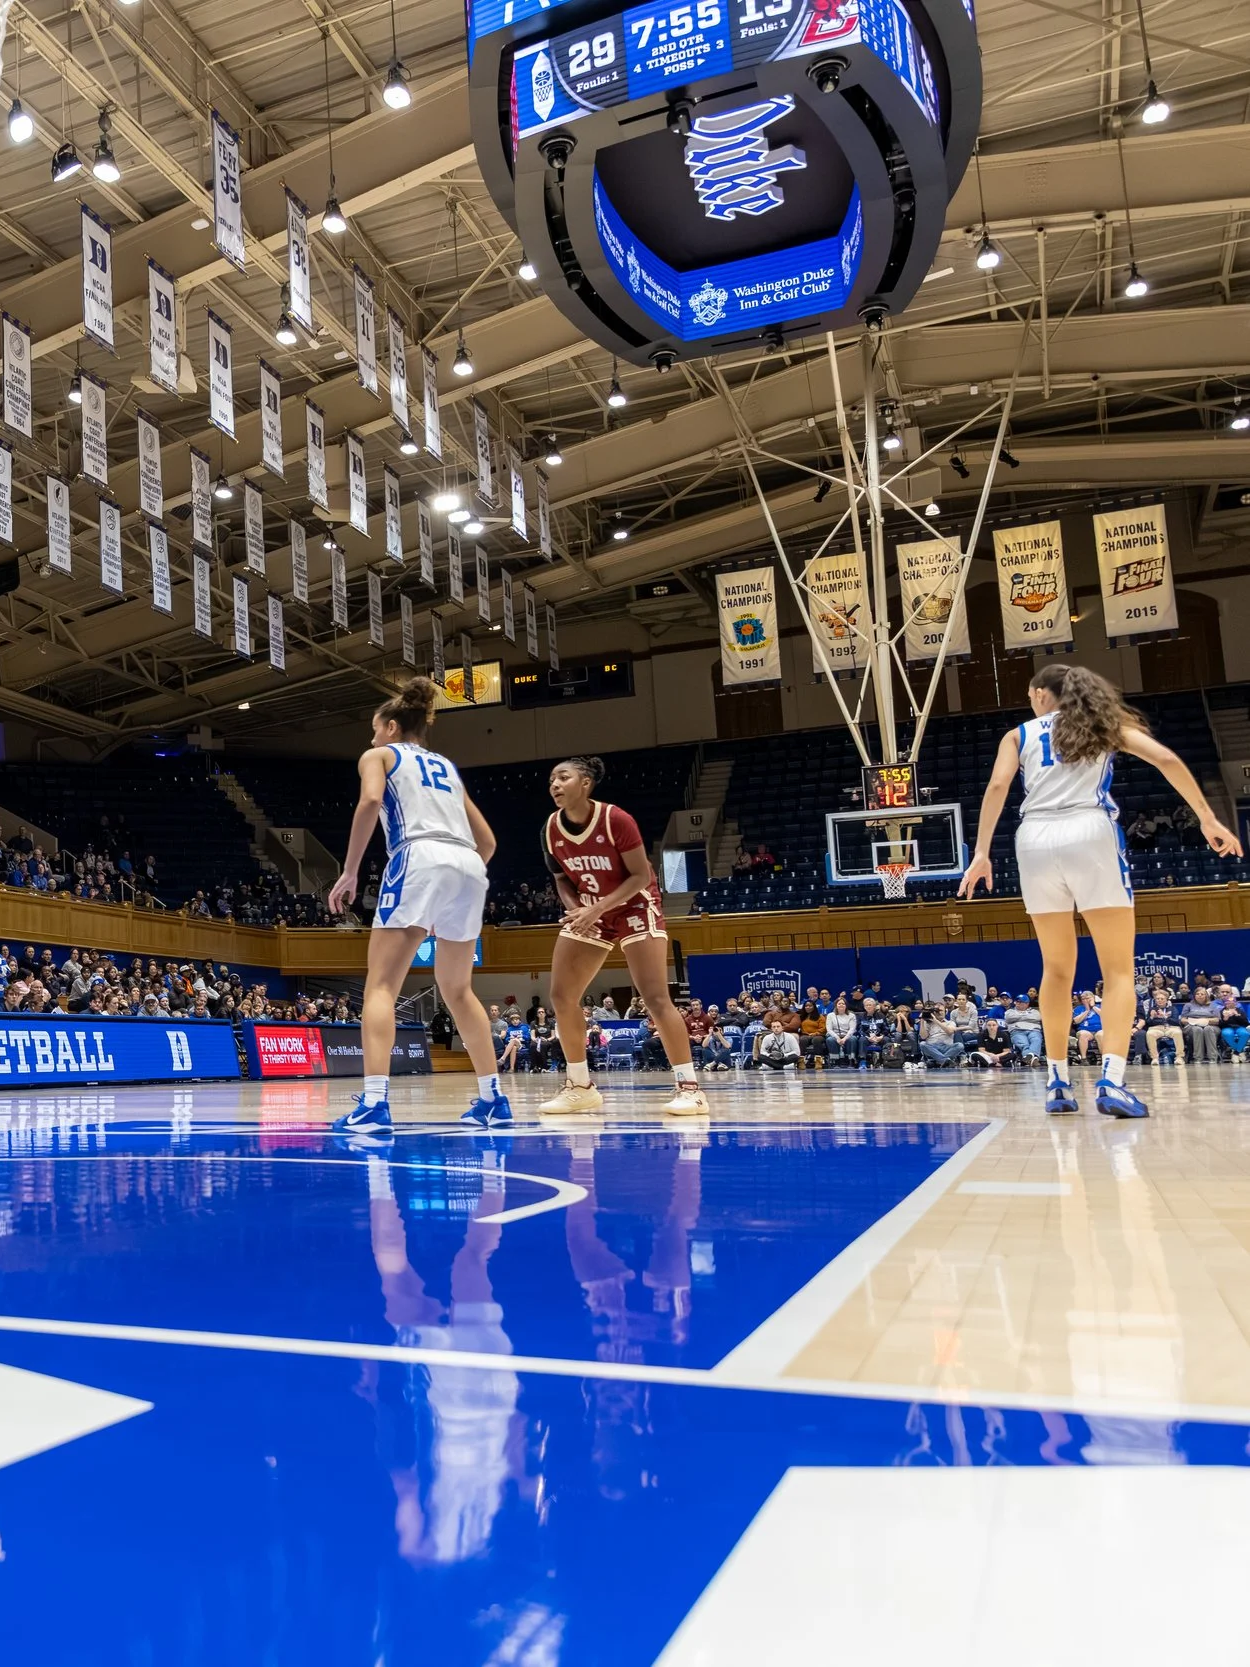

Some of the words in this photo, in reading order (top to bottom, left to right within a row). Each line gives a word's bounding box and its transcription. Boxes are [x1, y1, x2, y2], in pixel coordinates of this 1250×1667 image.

[631, 0, 721, 49] 7:55
[740, 21, 779, 39] Fouls:
[780, 18, 788, 28] 1
[568, 31, 616, 77] 29
[651, 41, 677, 57] 2ND
[679, 34, 704, 50] QTR
[633, 64, 642, 74] 4
[646, 43, 711, 70] TIMEOUTS
[716, 40, 725, 50] 3
[663, 61, 695, 76] POSS
[576, 75, 611, 93] Fouls:
[612, 71, 619, 81] 1
[220, 164, 239, 204] 35
[733, 276, 801, 298] Washington
[802, 267, 835, 283] Duke
[740, 297, 760, 310] Inn
[761, 294, 771, 305] &
[773, 286, 799, 303] Golf
[1105, 521, 1157, 539] NATIONAL
[1004, 537, 1053, 554] NATIONAL
[1100, 533, 1165, 552] CHAMPIONS
[1000, 549, 1060, 567] CHAMPIONS
[815, 567, 859, 582] NATIONAL
[725, 582, 768, 597] NATIONAL
[720, 593, 773, 609] CHAMPIONS
[1125, 605, 1158, 619] 2015
[1023, 619, 1053, 632] 2010
[923, 633, 952, 645] 200
[830, 645, 857, 658] 1992
[739, 658, 765, 670] 1991
[514, 674, 538, 684] DUKE
[1038, 732, 1062, 768] 1
[415, 755, 452, 794] 12
[878, 767, 911, 782] 7:55
[884, 782, 908, 806] 12
[562, 855, 613, 872] BOSTON
[580, 873, 600, 893] 3
[1134, 965, 1183, 979] STERHOOD
[746, 979, 797, 993] SISTERHOOD
[259, 1036, 278, 1052] FAN
[278, 1037, 305, 1053] WORK
[262, 1054, 269, 1064] IS
[268, 1054, 291, 1064] THIRSTY
[290, 1053, 308, 1064] WORK
